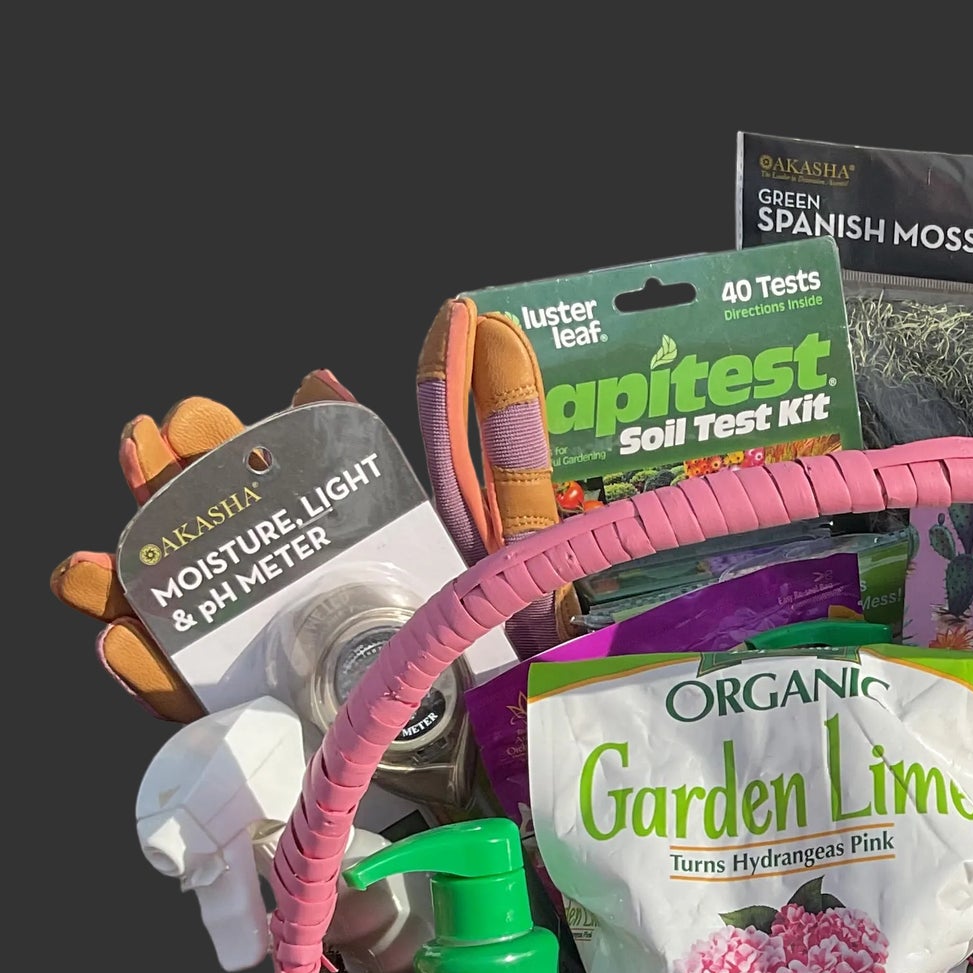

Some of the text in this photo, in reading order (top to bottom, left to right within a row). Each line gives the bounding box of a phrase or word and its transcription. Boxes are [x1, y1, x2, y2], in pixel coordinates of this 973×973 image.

[773, 157, 850, 179] AKASHA
[758, 189, 820, 211] GREEN
[758, 207, 886, 243] SPANISH
[721, 269, 821, 304] 40 Tests
[521, 299, 597, 329] luster
[724, 294, 823, 321] Directions Inside
[552, 320, 602, 349] leaf
[546, 332, 832, 437] apitest
[620, 393, 831, 455] Soil Test Kit
[555, 446, 568, 456] for
[562, 451, 606, 465] Gardening
[151, 454, 384, 607] MOISTURE, LIGHT
[161, 488, 262, 557] AKASHA
[171, 526, 331, 632] & pH METER
[666, 667, 891, 723] ORGANIC
[402, 712, 438, 737] METER
[580, 740, 808, 841] Garden
[669, 832, 895, 875] Turns Hydrangeas Pink
